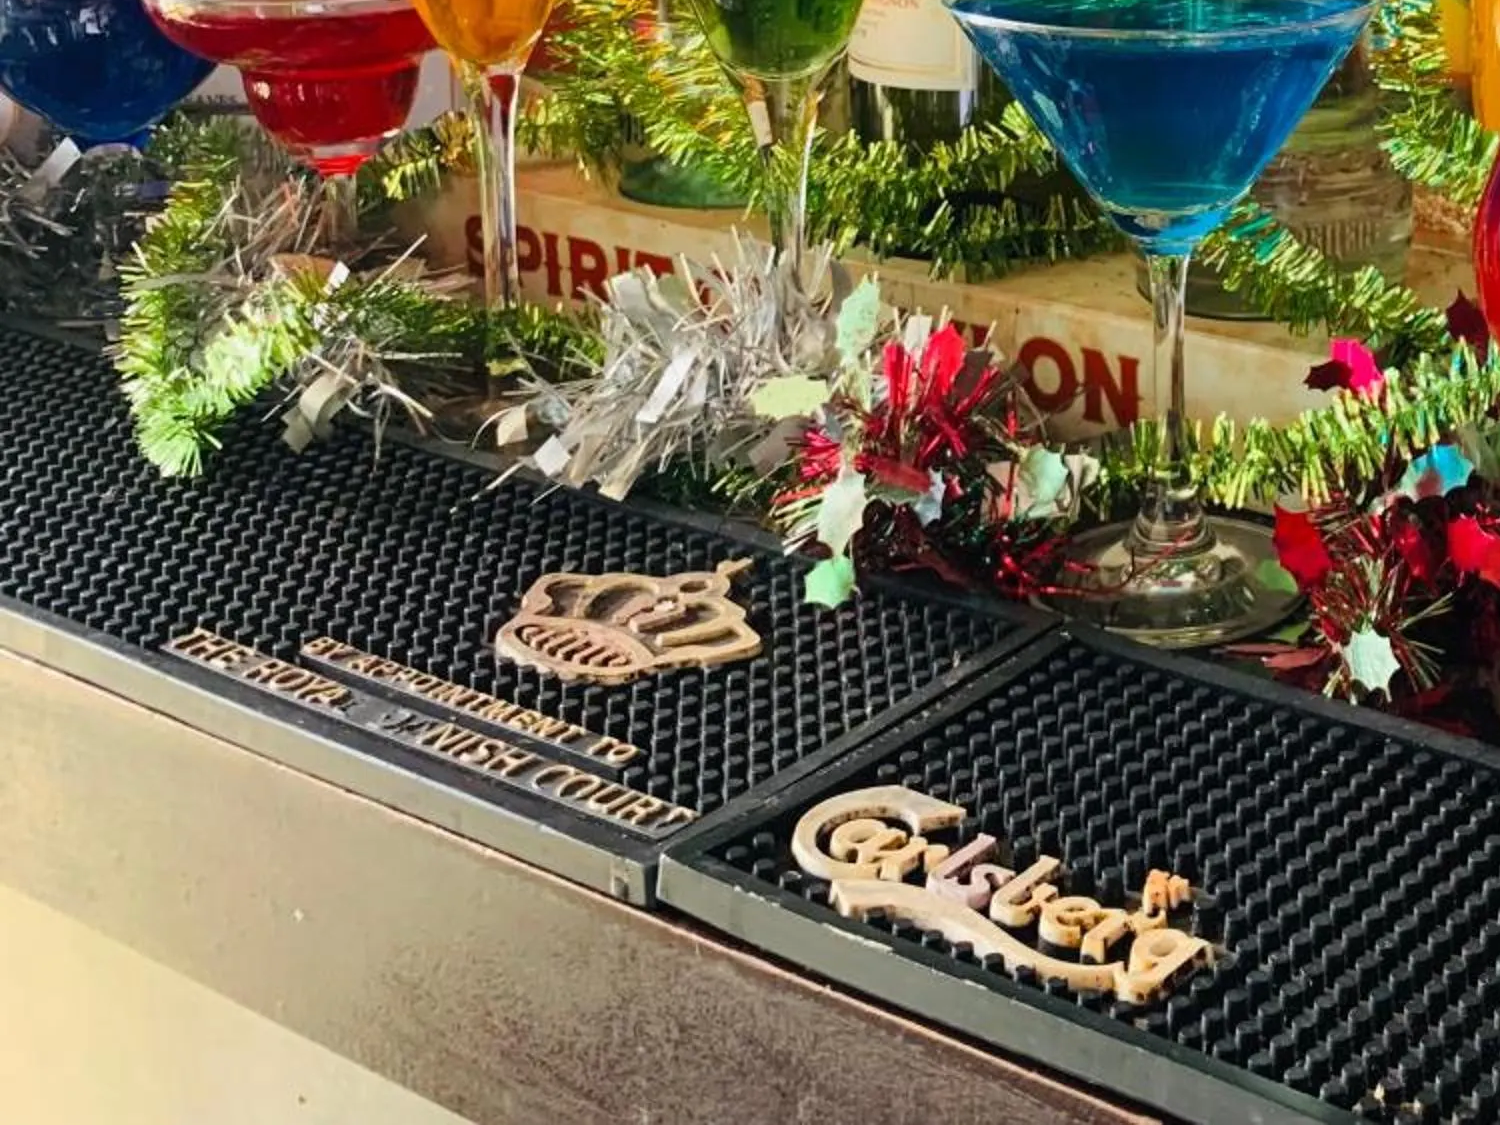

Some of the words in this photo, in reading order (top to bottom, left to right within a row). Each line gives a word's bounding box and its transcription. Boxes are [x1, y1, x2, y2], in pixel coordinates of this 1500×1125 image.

[172, 627, 248, 670] THE
[530, 762, 699, 828] COURT
[304, 635, 344, 661] BY
[588, 735, 640, 764] TO
